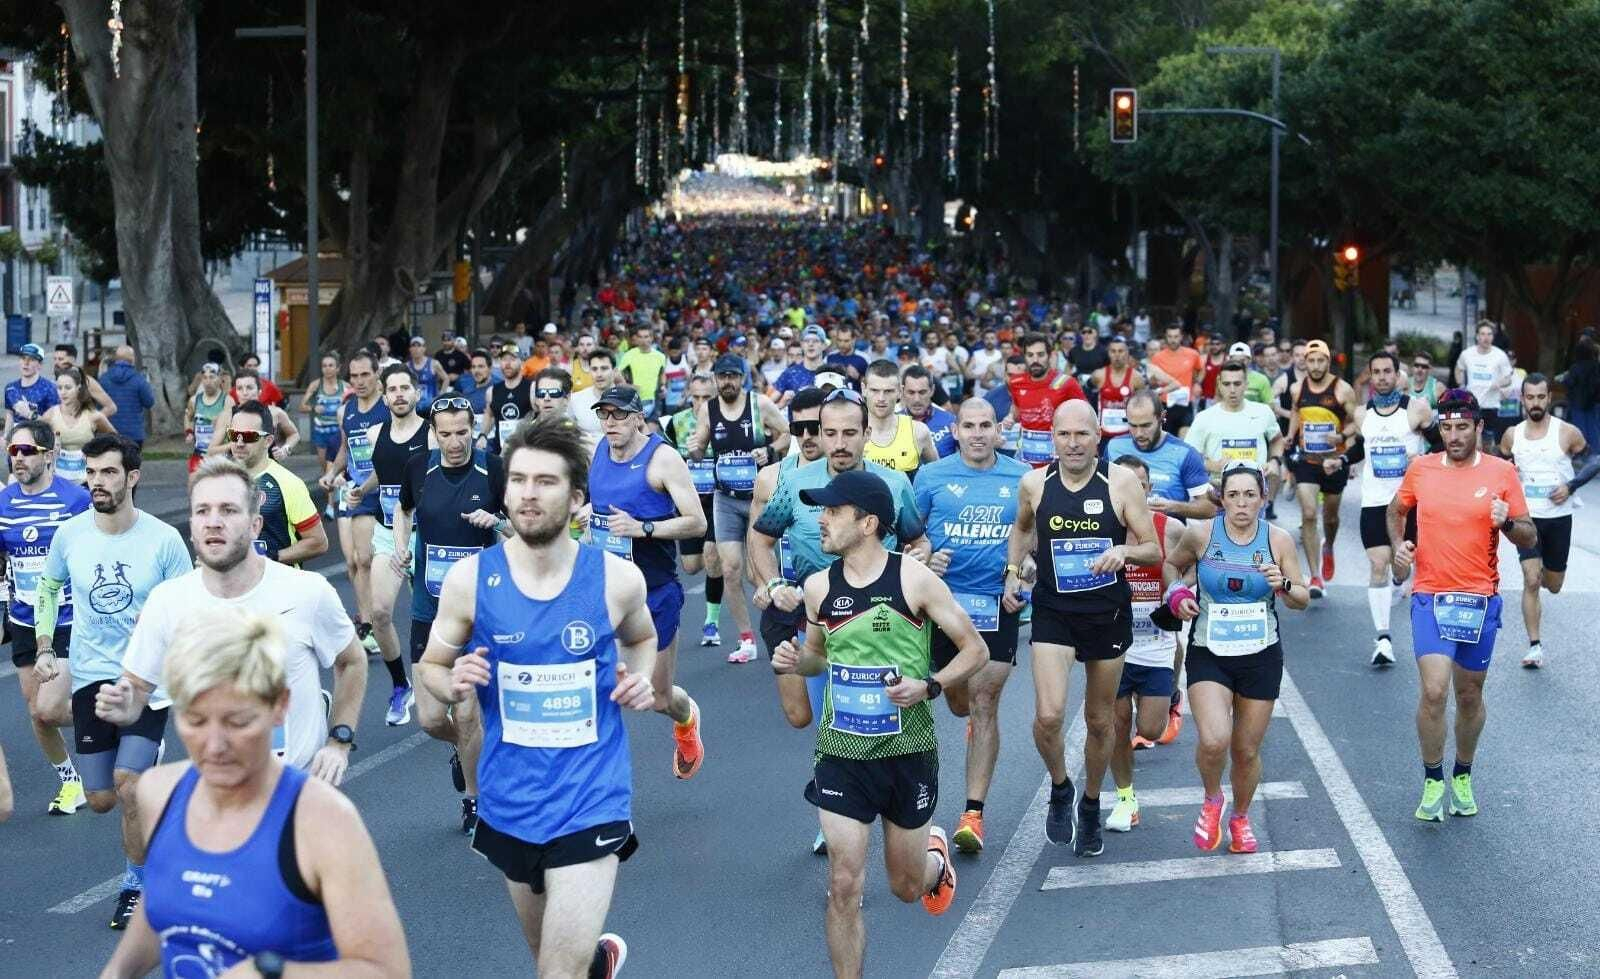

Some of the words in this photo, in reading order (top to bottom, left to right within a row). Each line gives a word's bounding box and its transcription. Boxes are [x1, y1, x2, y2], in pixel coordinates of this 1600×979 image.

[959, 504, 1004, 523] 42K
[836, 599, 850, 608] KIA
[537, 673, 576, 682] ZURICH
[543, 696, 581, 710] 4898
[859, 694, 881, 704] 481
